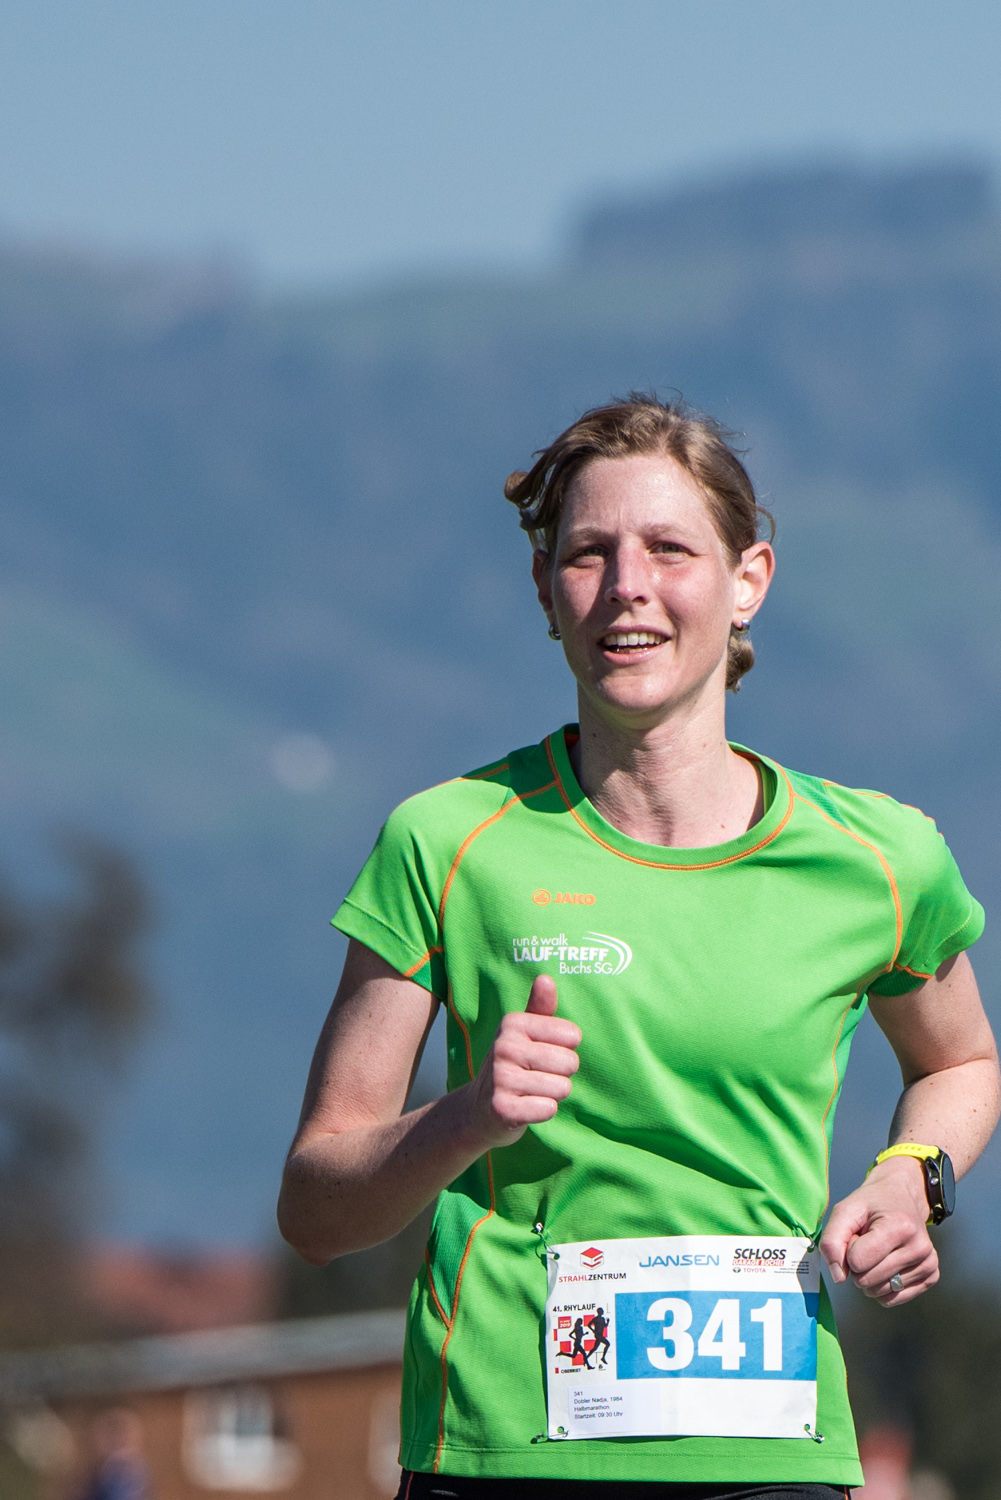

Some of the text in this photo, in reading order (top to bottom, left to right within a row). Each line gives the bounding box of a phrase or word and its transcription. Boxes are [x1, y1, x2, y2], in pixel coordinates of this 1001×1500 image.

[554, 892, 596, 906] JAKO
[512, 933, 569, 947] run & walk
[513, 946, 610, 962] LAUF-TREFF
[559, 961, 613, 974] Buchs SG
[639, 1254, 720, 1268] JANSEN
[733, 1248, 787, 1260] SCHLOSS
[558, 1272, 627, 1284] STRAHLZENTRUM
[552, 1303, 596, 1313] 41. RHYLAUF
[646, 1297, 783, 1372] 341
